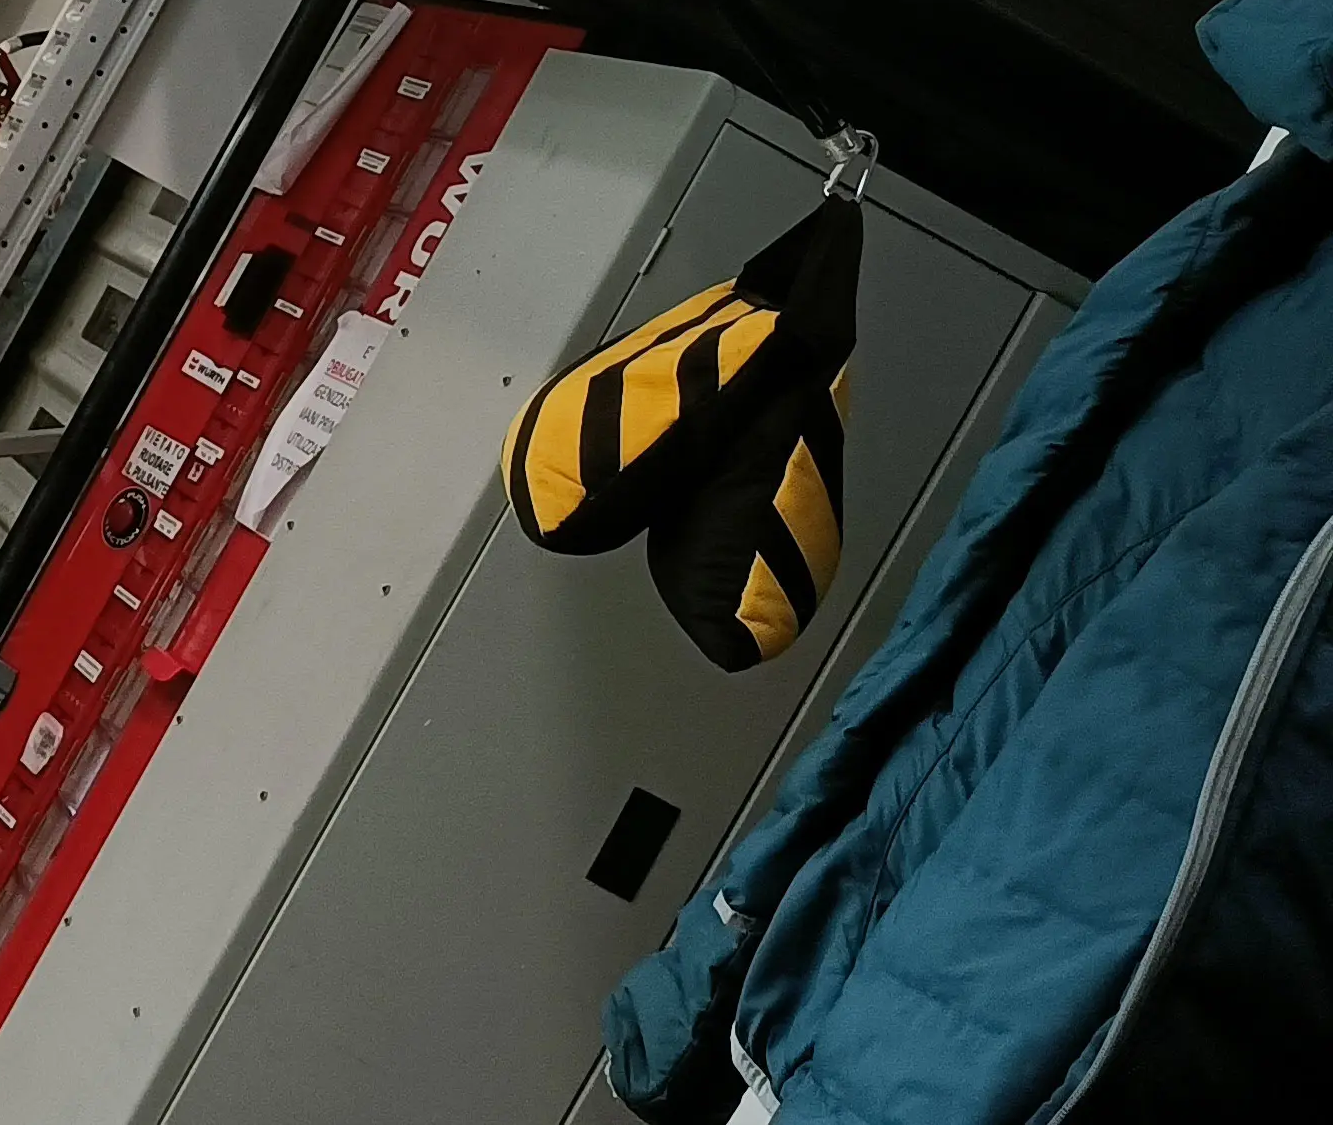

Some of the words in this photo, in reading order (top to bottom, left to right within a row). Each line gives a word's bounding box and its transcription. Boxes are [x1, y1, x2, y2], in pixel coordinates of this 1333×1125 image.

[144, 427, 186, 460] VIETATO
[138, 447, 174, 477] RUOTARE
[132, 465, 170, 496] PULSANTE
